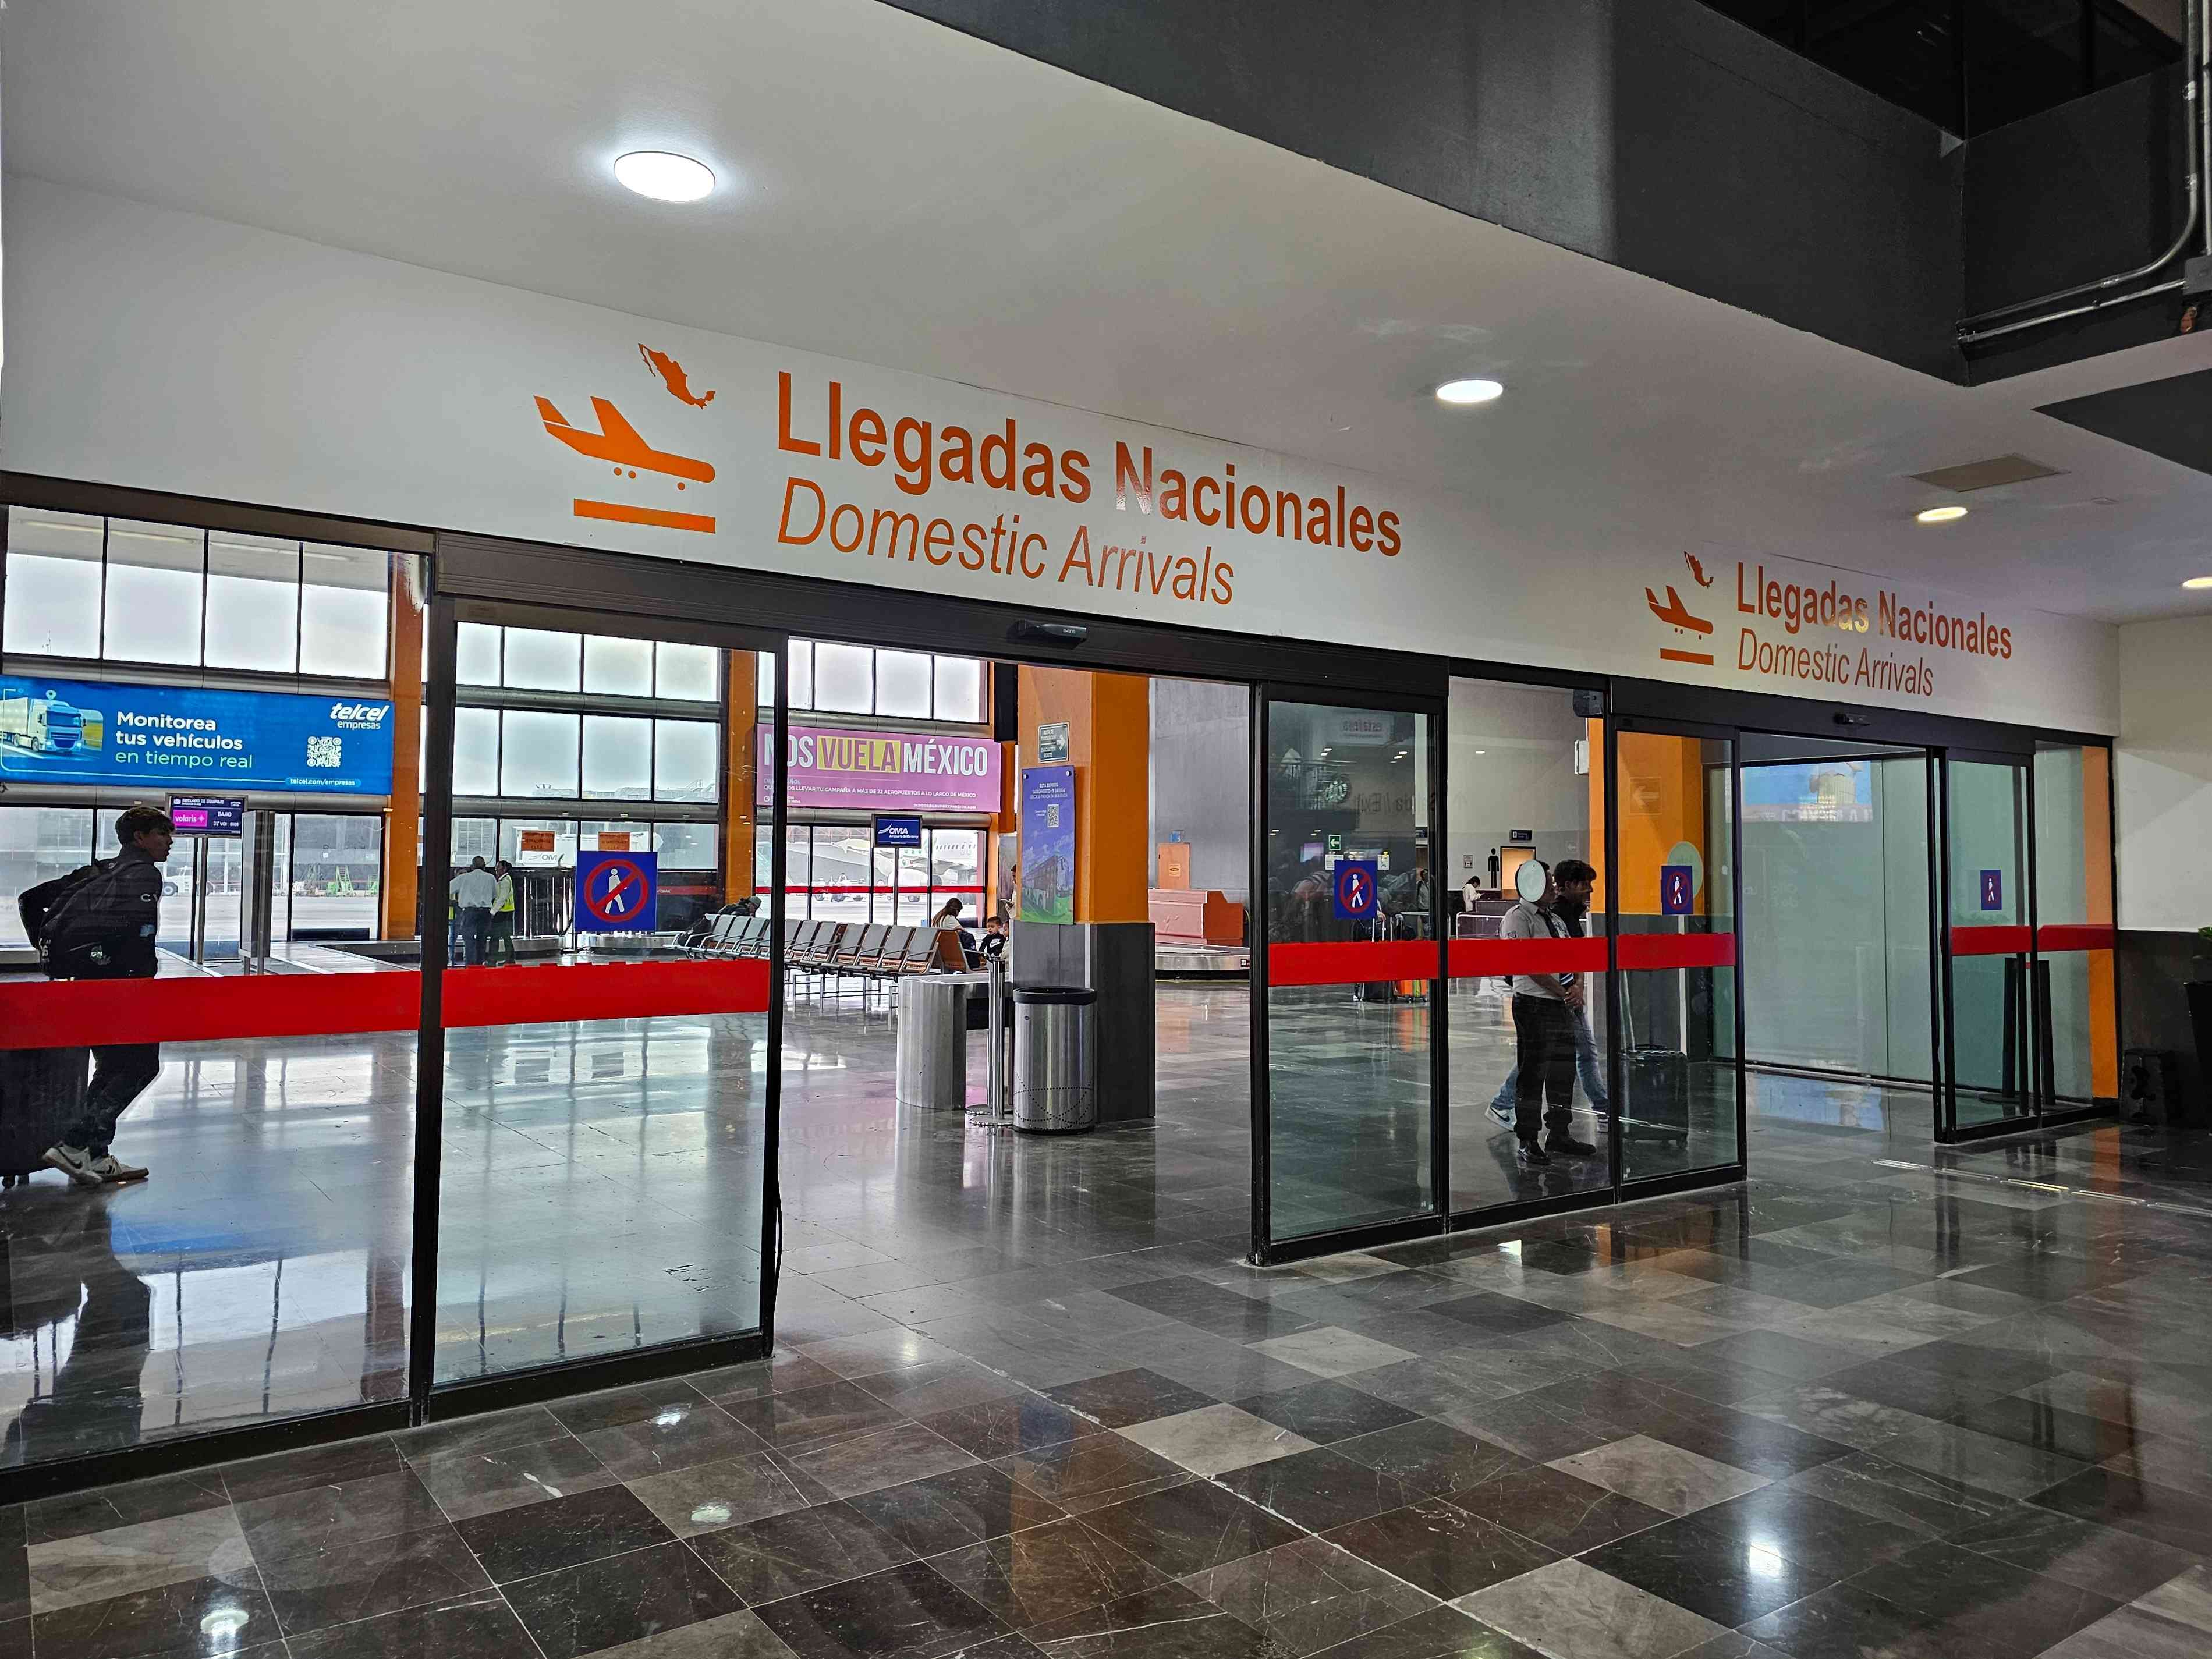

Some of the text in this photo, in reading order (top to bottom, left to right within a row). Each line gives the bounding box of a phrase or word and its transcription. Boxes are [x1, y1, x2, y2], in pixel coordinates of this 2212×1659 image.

[778, 371, 1401, 556] Llegadas Nacionales
[778, 477, 1235, 605] Domestic Arrivals
[1738, 562, 2012, 659] Llegadas Nacionales
[1738, 628, 1933, 697] Domestic Arrivals
[117, 711, 216, 731] Monitorea
[330, 703, 389, 721] telcel
[337, 721, 381, 730] empresas
[116, 731, 243, 750] tus vehículos
[115, 750, 253, 768] en tiempo real
[821, 738, 896, 772] VUELA
[903, 738, 988, 777] MÉXICO
[290, 778, 356, 786] telcel.com/empresas
[175, 814, 197, 823] volaris
